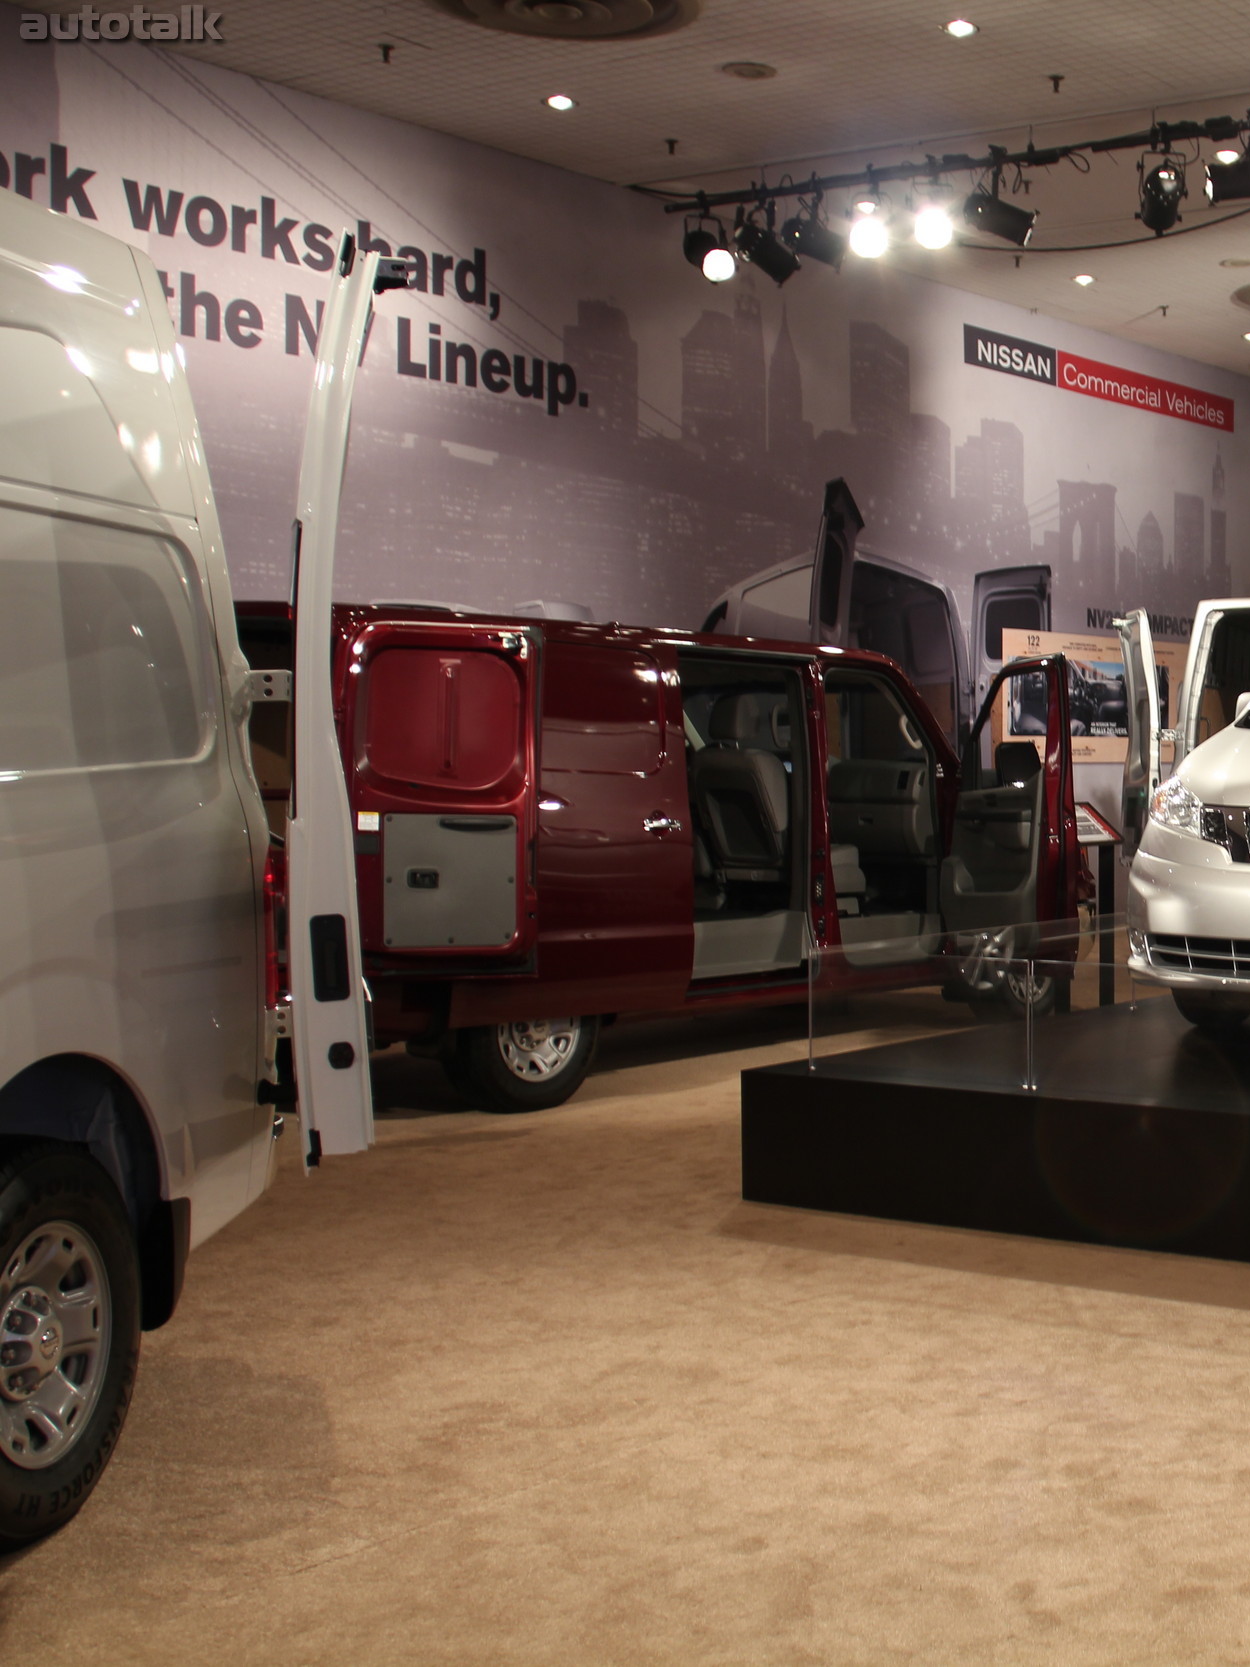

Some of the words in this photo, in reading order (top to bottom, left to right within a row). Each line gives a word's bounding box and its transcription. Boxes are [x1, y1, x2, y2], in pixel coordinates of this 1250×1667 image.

[0, 142, 98, 221] rk
[123, 177, 334, 272] works
[397, 317, 590, 416] Lineup.
[977, 338, 1052, 379] NISSAN
[1063, 362, 1161, 408] Commercial
[1166, 392, 1226, 425] Vehicles
